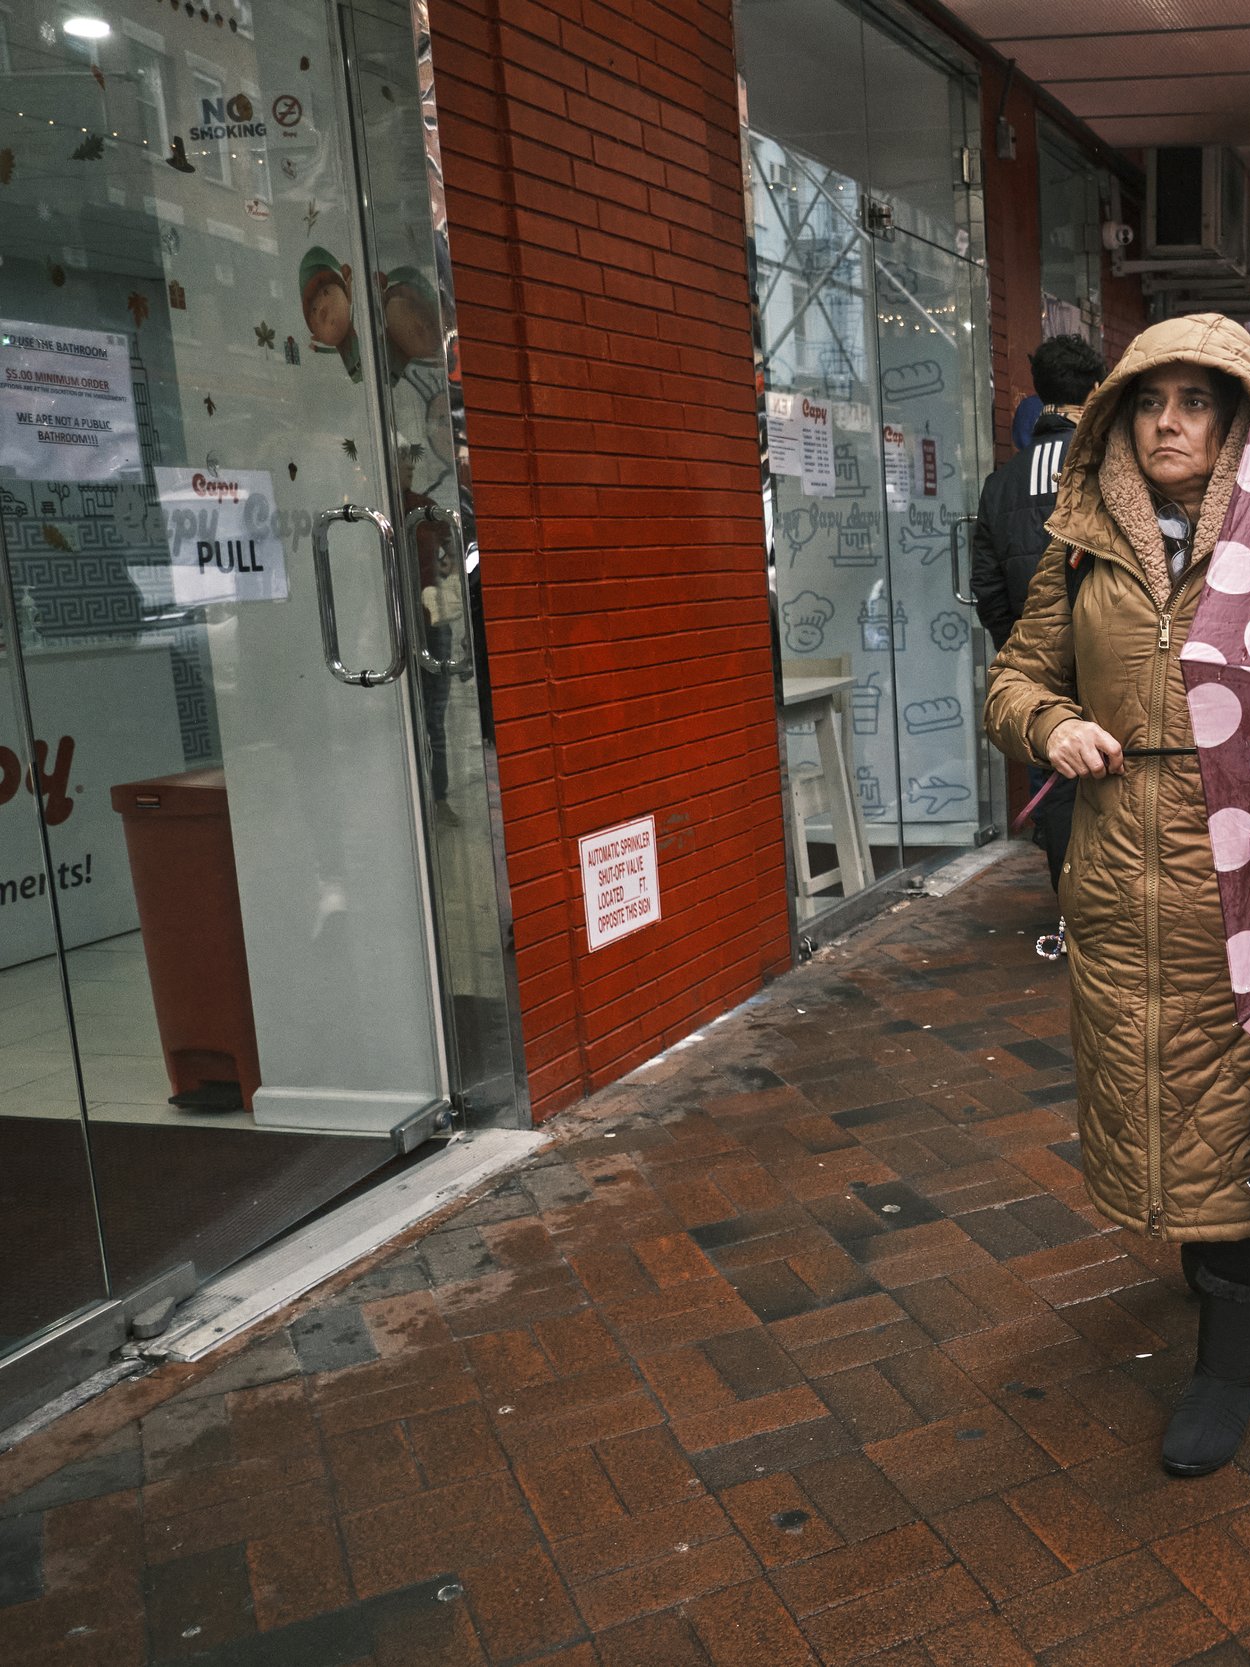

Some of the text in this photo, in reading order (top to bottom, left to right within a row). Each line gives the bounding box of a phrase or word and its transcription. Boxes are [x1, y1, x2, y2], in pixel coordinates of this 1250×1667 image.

[202, 94, 253, 124] NO
[190, 123, 267, 140] SMOKING
[19, 336, 36, 348] USE
[36, 338, 54, 350] THE
[56, 342, 108, 358] BATHROOM
[5, 367, 109, 390] $5.00 MINIMUM ORDER
[16, 412, 112, 430] WE ARE NOT A PUBLIC
[802, 398, 828, 426] Capy
[38, 430, 99, 445] BATHROOM!!!
[192, 473, 239, 504] Capy
[197, 540, 264, 575] PULL
[588, 831, 650, 868] AUTOMATIC SPRINKLER
[598, 855, 644, 887] SHUT-OFF VALVE
[597, 885, 625, 911] LOCATED
[598, 897, 651, 934] OPPOSITE THIS SIGN
